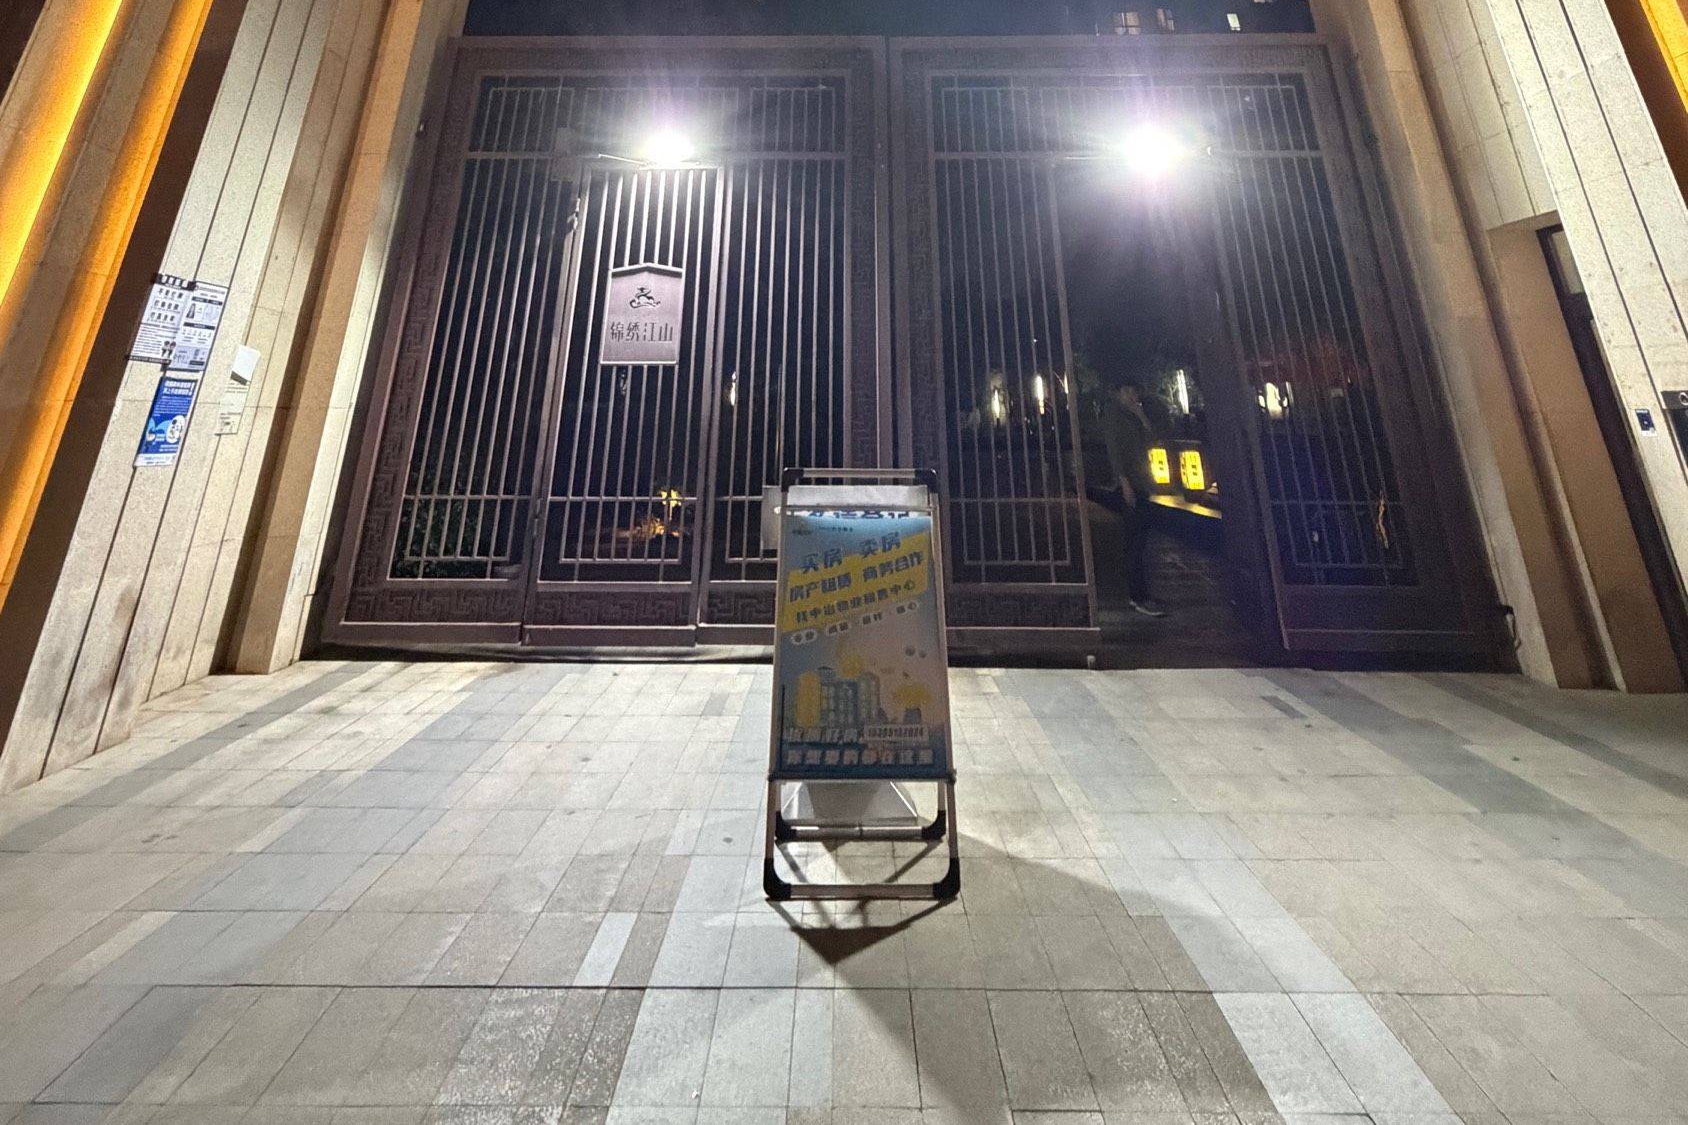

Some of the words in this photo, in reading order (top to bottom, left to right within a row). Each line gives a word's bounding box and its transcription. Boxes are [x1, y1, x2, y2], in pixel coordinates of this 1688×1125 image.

[610, 321, 674, 343] 锦绣江山
[863, 552, 924, 582] 商务合作
